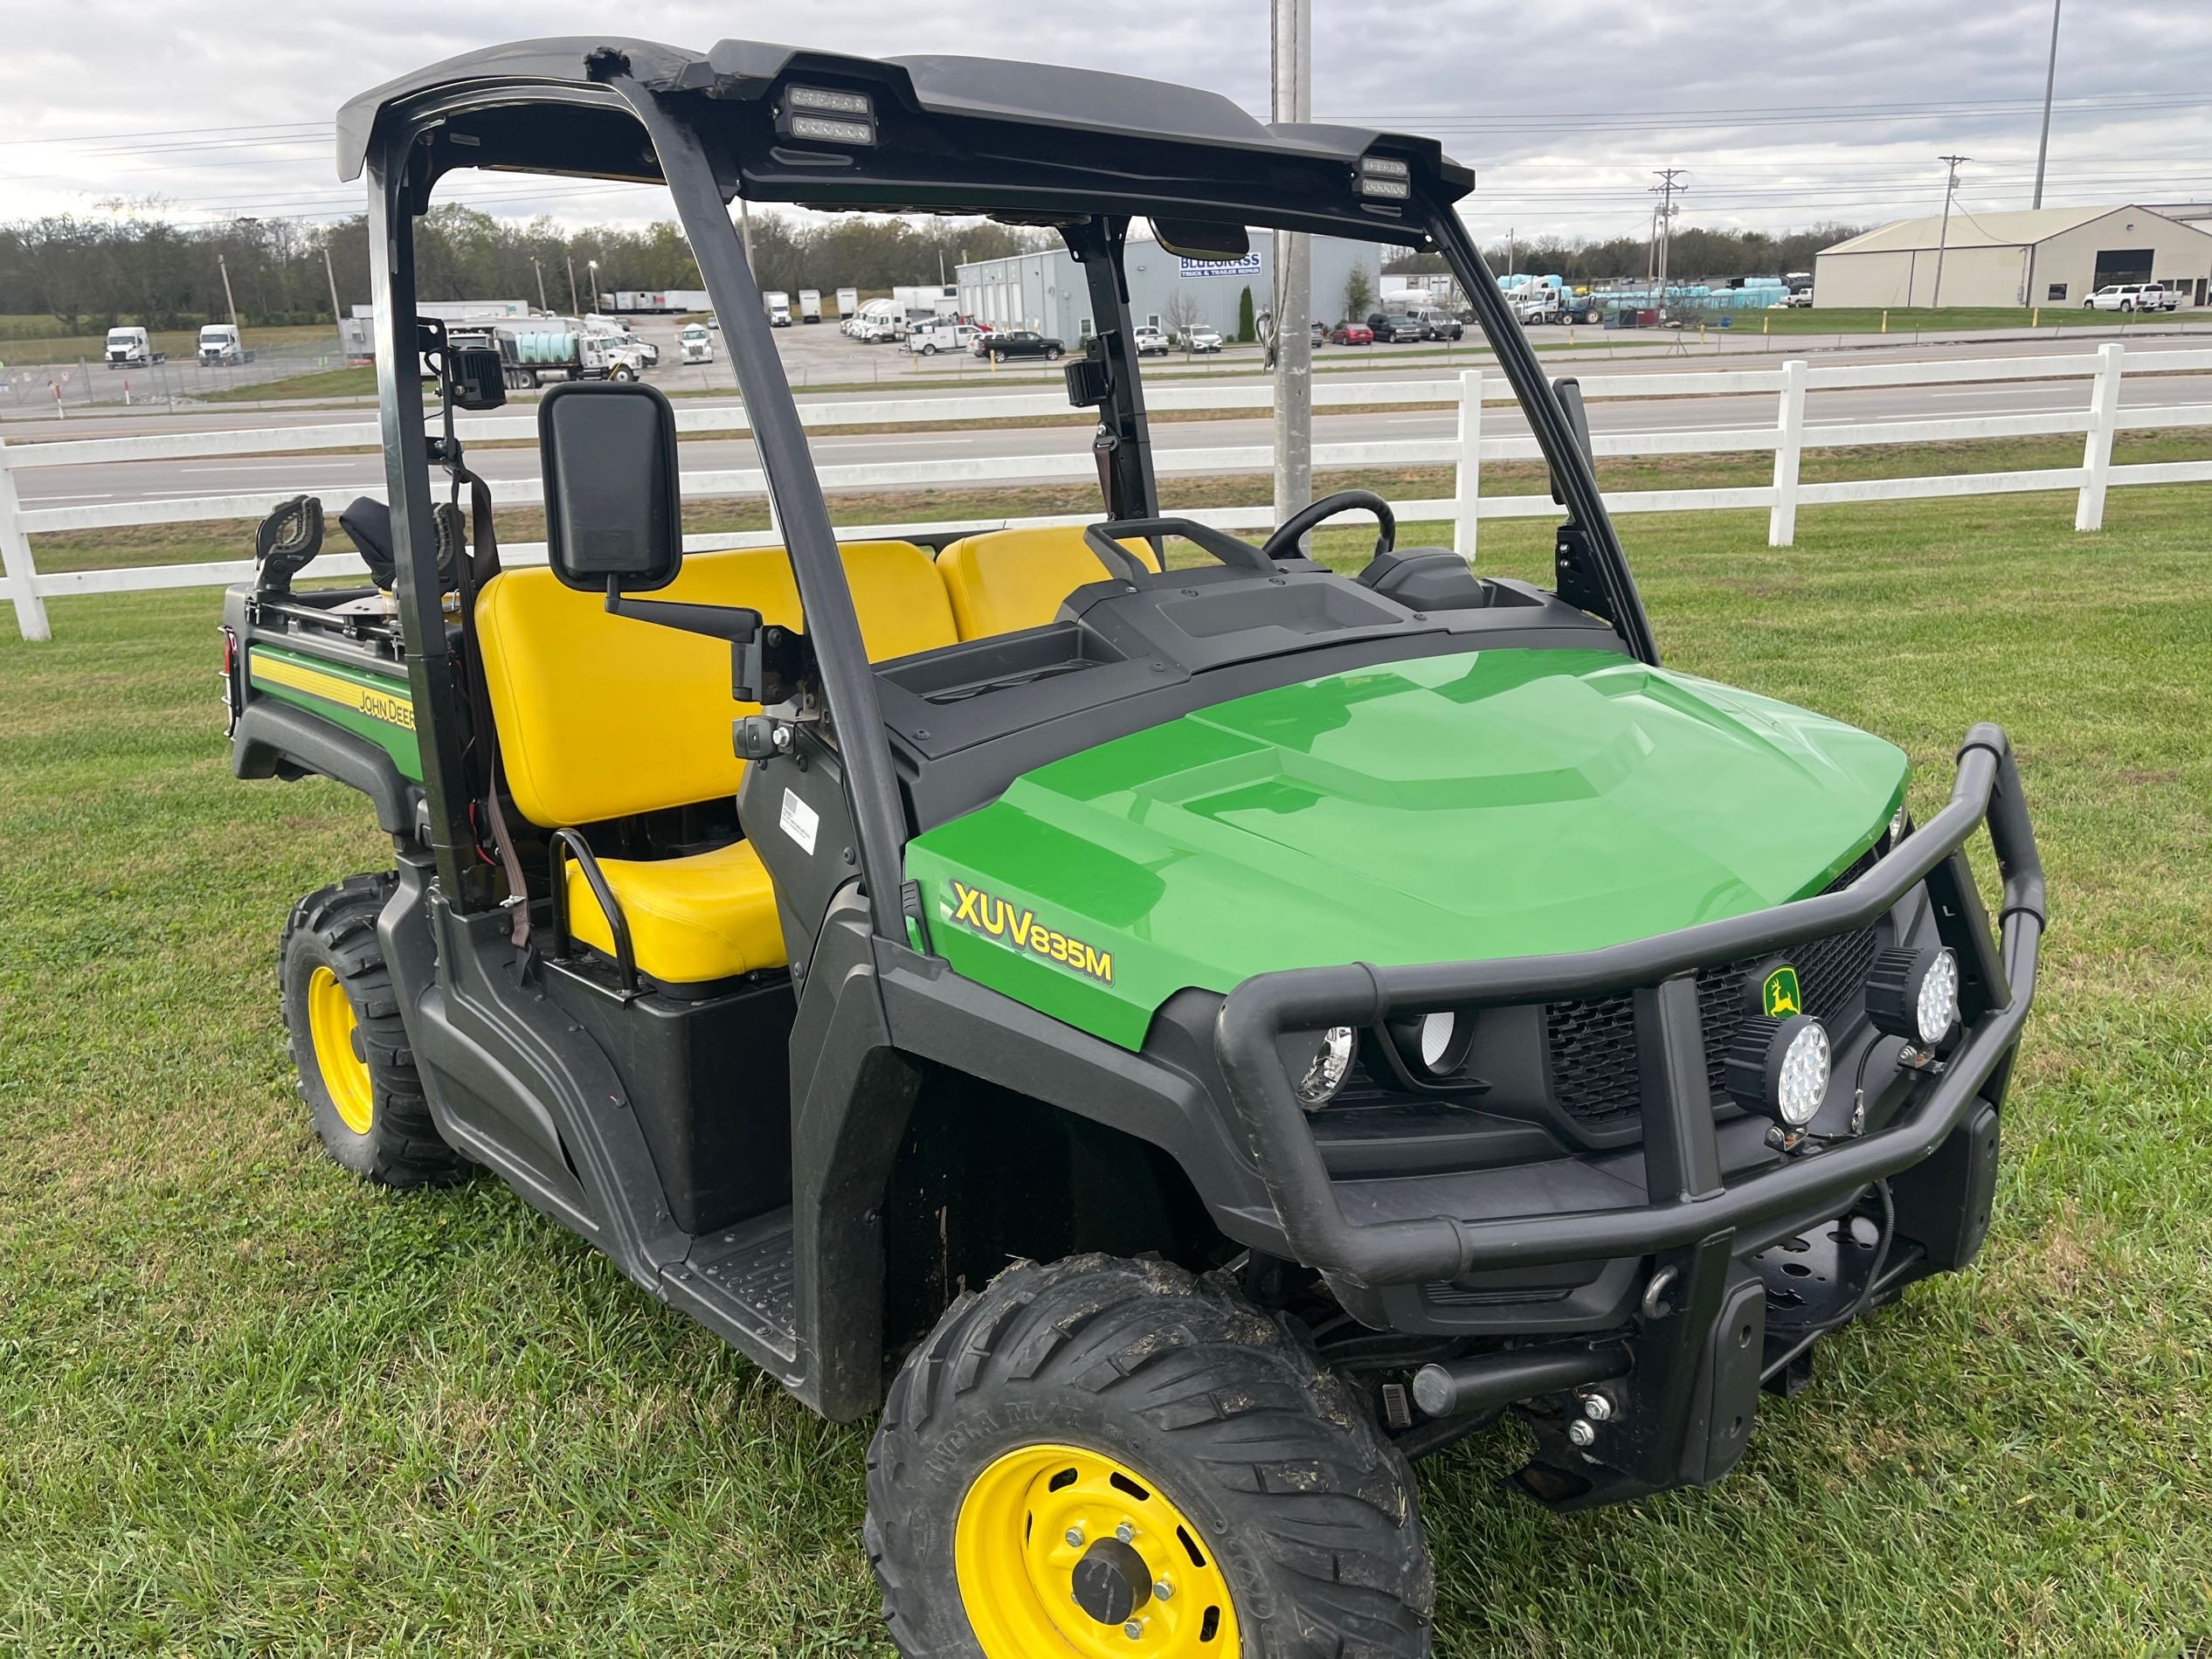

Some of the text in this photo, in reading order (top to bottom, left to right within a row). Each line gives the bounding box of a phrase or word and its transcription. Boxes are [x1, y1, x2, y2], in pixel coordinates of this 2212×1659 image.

[1181, 254, 1260, 269] BLUEGRASS
[360, 691, 417, 727] JOHN DEER
[954, 881, 1112, 982] XUV835M
